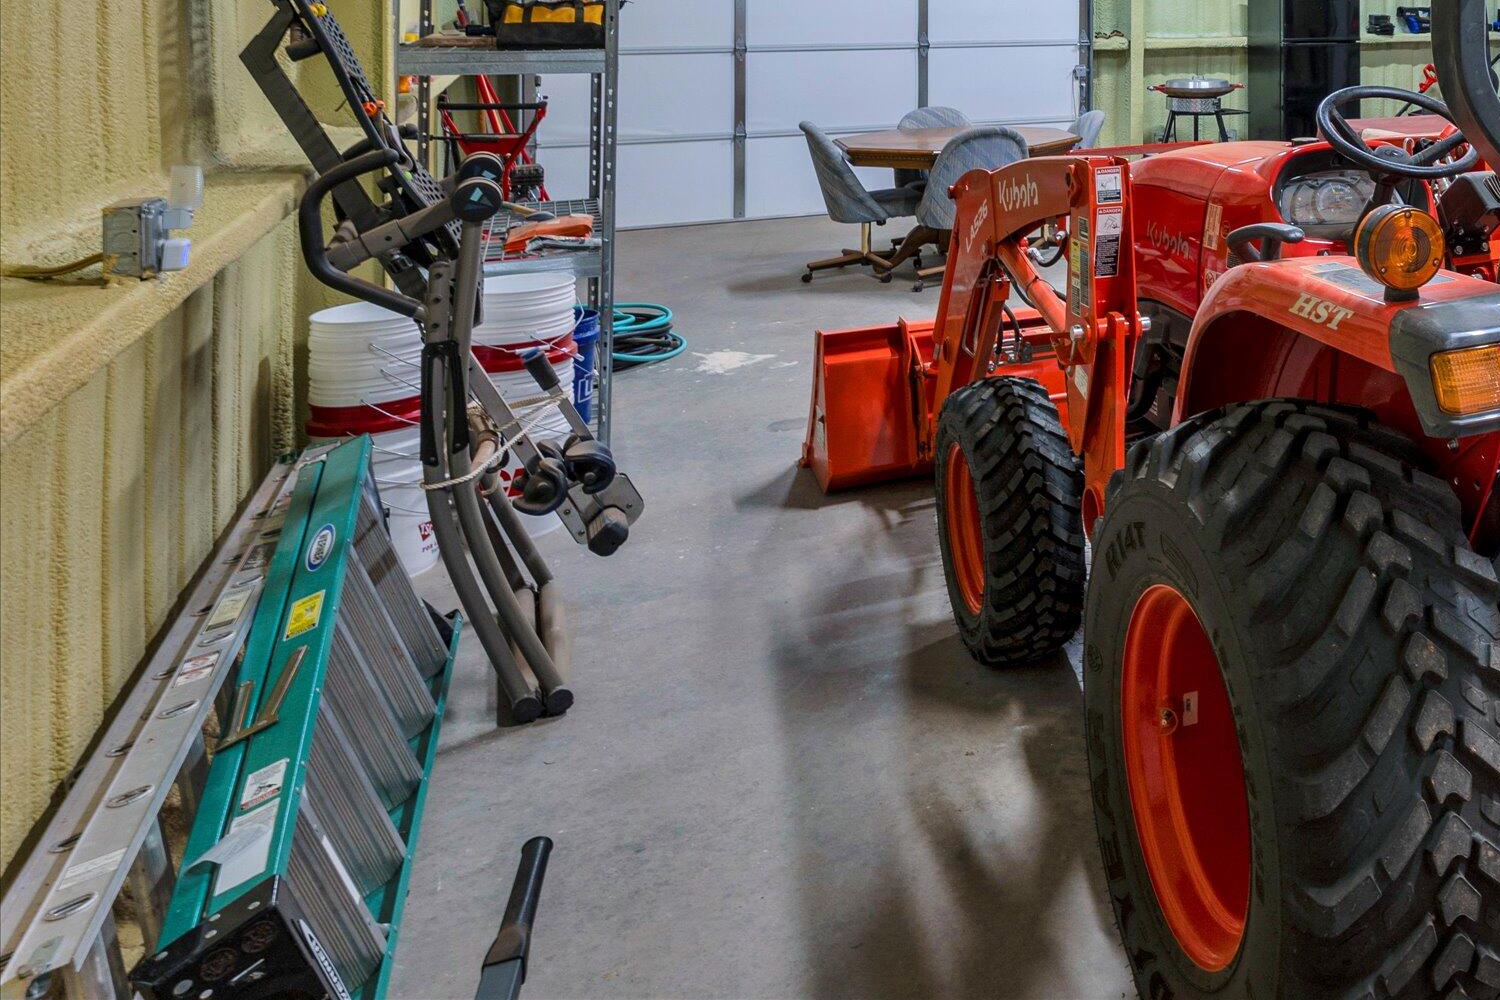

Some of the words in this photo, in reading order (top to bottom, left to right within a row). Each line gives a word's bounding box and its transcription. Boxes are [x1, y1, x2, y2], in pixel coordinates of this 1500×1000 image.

[999, 173, 1039, 212] Kubota
[1146, 220, 1191, 261] Kubota
[1288, 292, 1355, 330] HST
[1105, 521, 1146, 580] R14T
